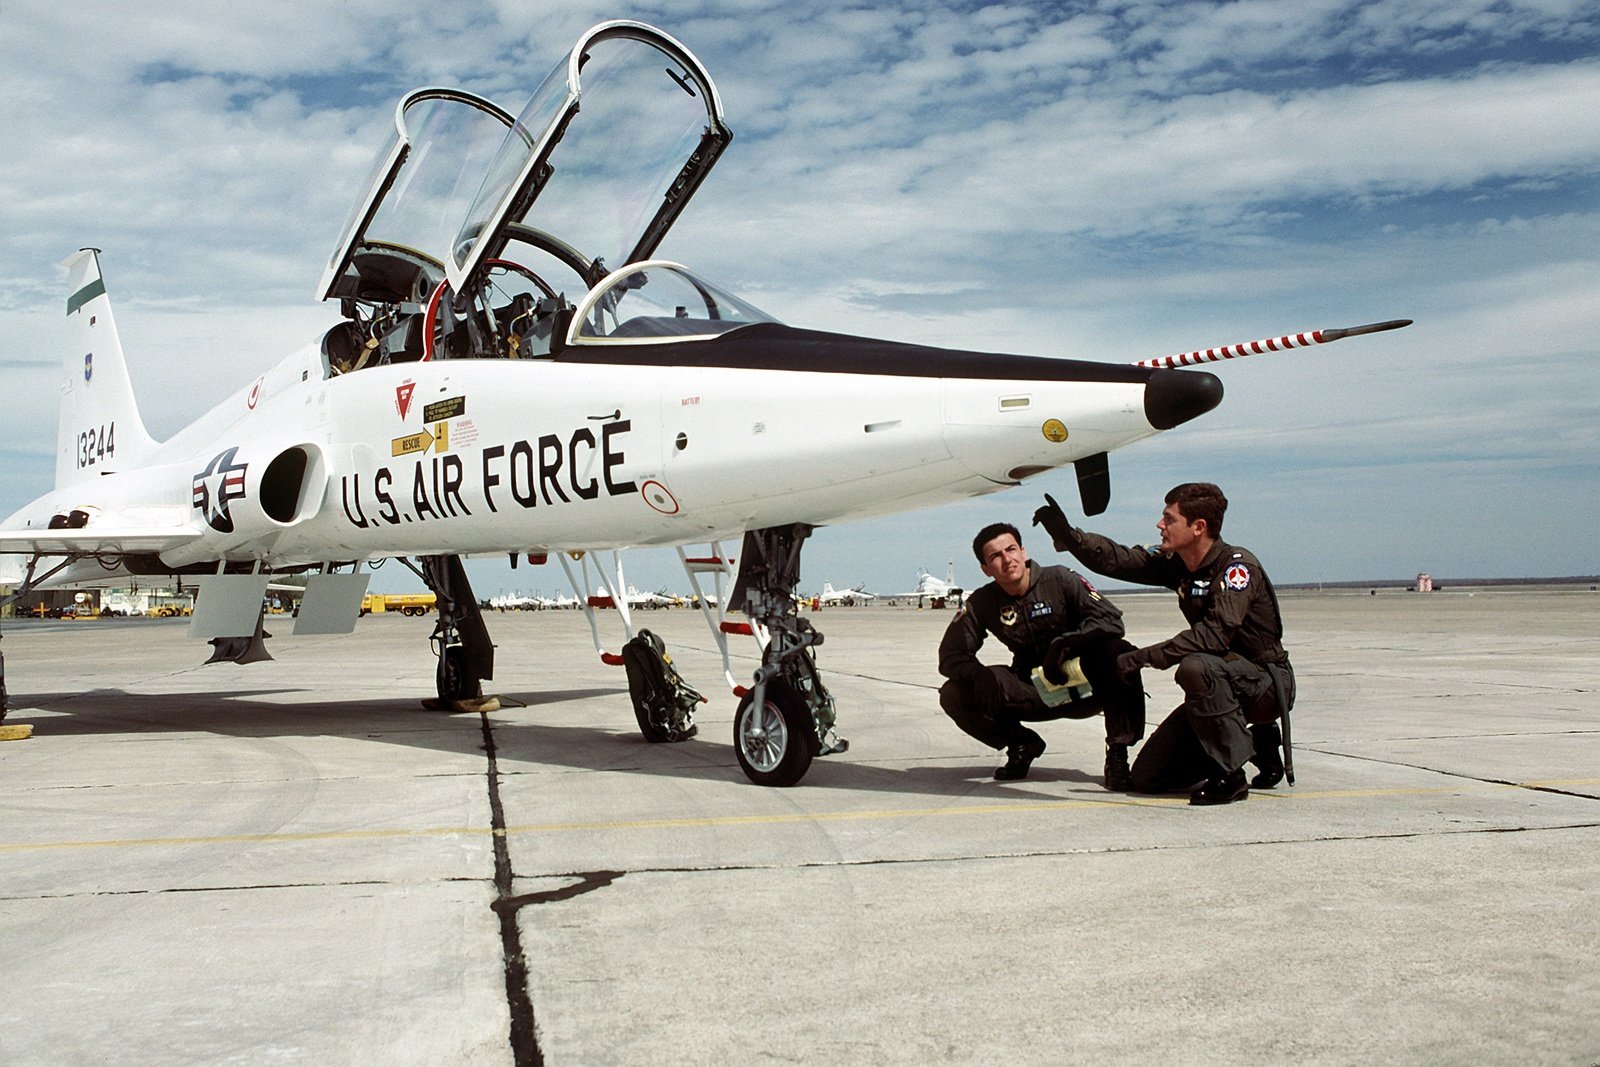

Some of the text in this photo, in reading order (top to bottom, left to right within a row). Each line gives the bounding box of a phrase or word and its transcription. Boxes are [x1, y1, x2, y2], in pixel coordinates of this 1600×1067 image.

[77, 421, 114, 470] 13244
[402, 436, 421, 451] RESCUE
[413, 454, 472, 521] AIR
[482, 419, 639, 514] FORCE
